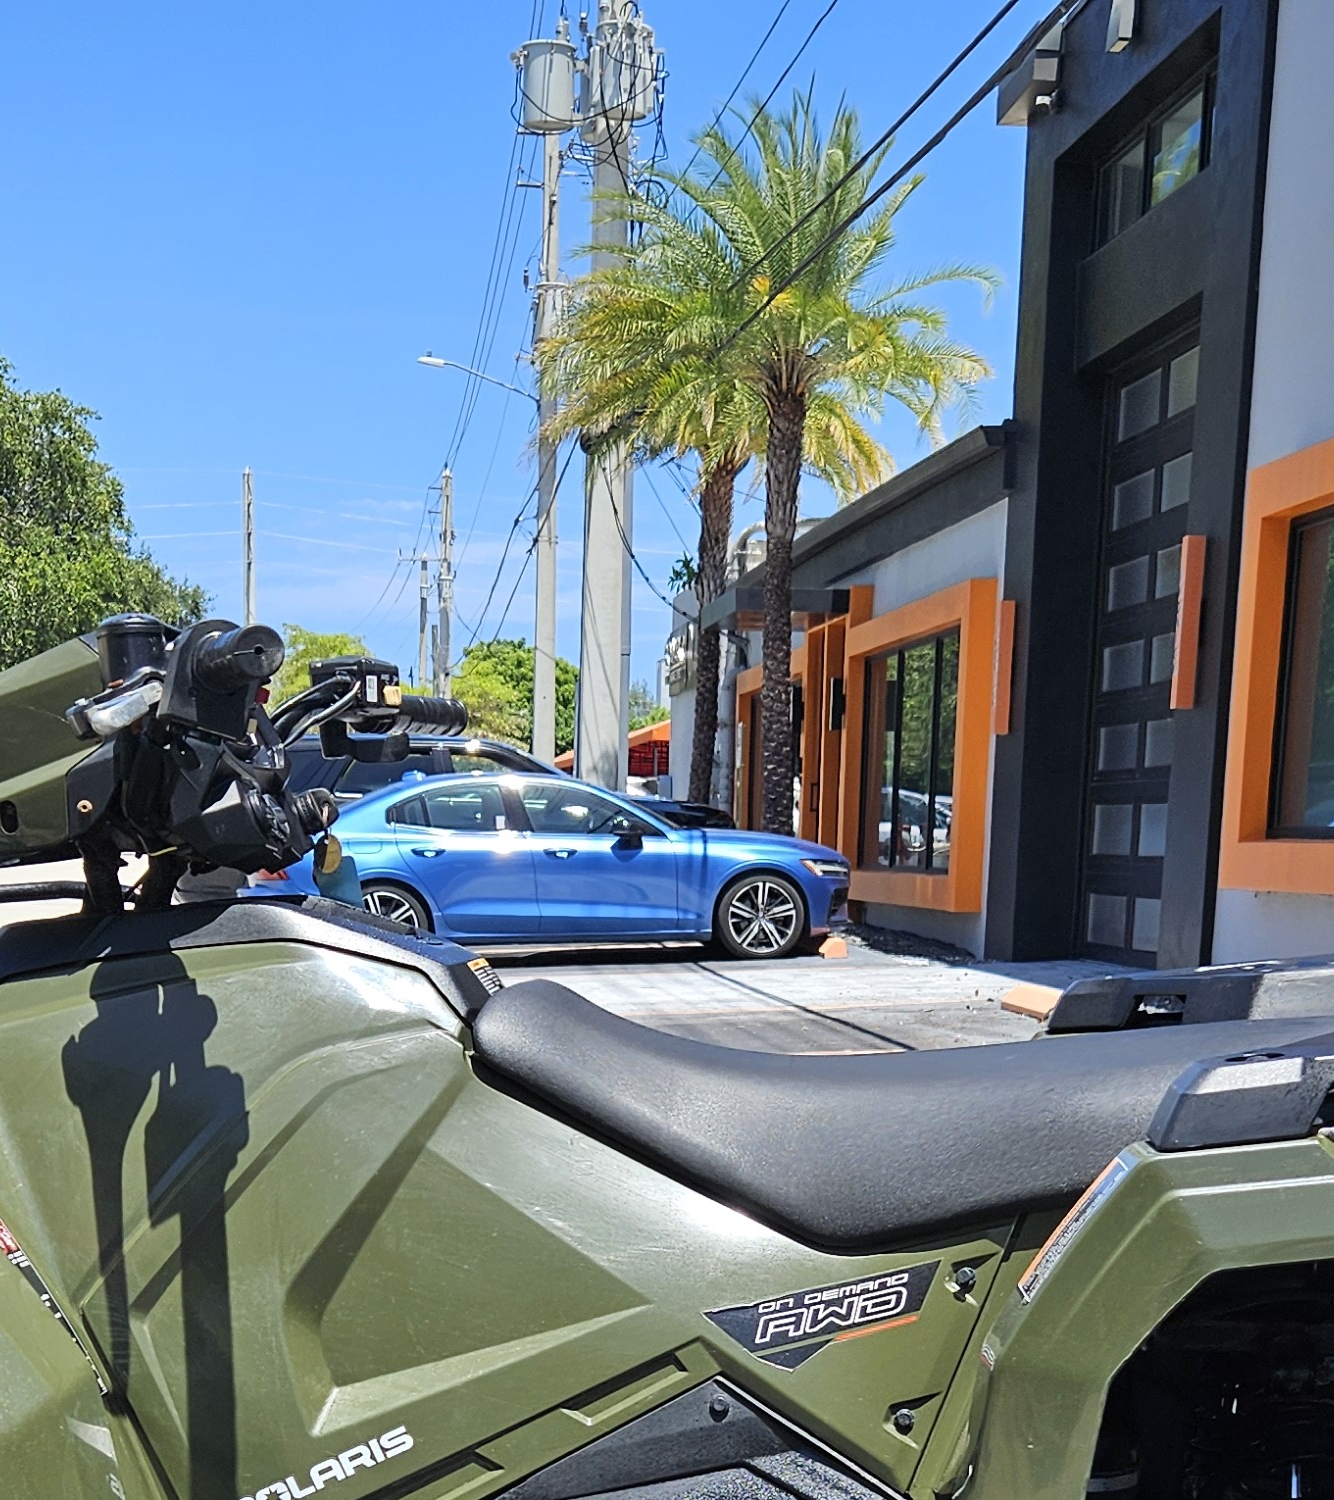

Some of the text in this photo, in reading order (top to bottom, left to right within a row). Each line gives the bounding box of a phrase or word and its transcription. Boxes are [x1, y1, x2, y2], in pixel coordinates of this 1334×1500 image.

[754, 1286, 907, 1344] AWD
[758, 1273, 909, 1314] ON DEMAND
